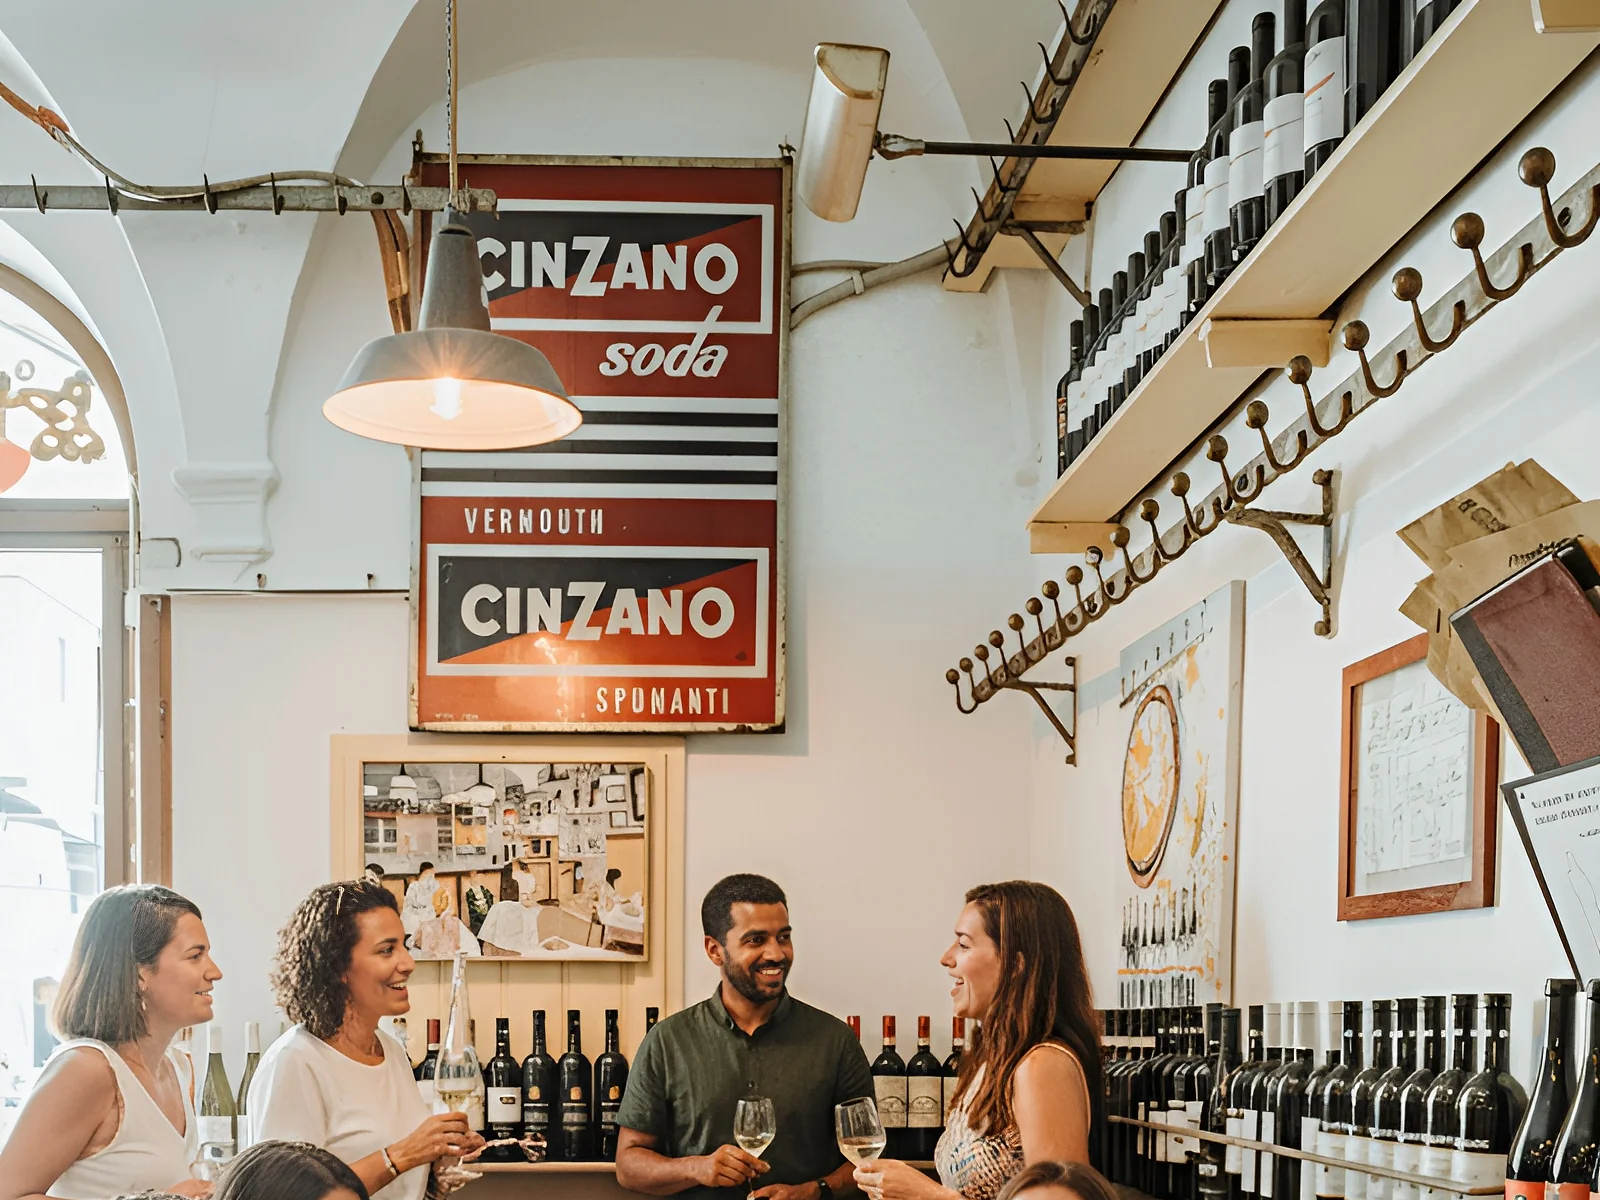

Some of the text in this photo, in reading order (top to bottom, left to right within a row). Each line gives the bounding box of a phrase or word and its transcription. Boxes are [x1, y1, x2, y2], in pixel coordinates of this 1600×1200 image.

[477, 237, 739, 297] CINZANO
[598, 305, 729, 377] soda
[460, 582, 735, 641] CINZANO
